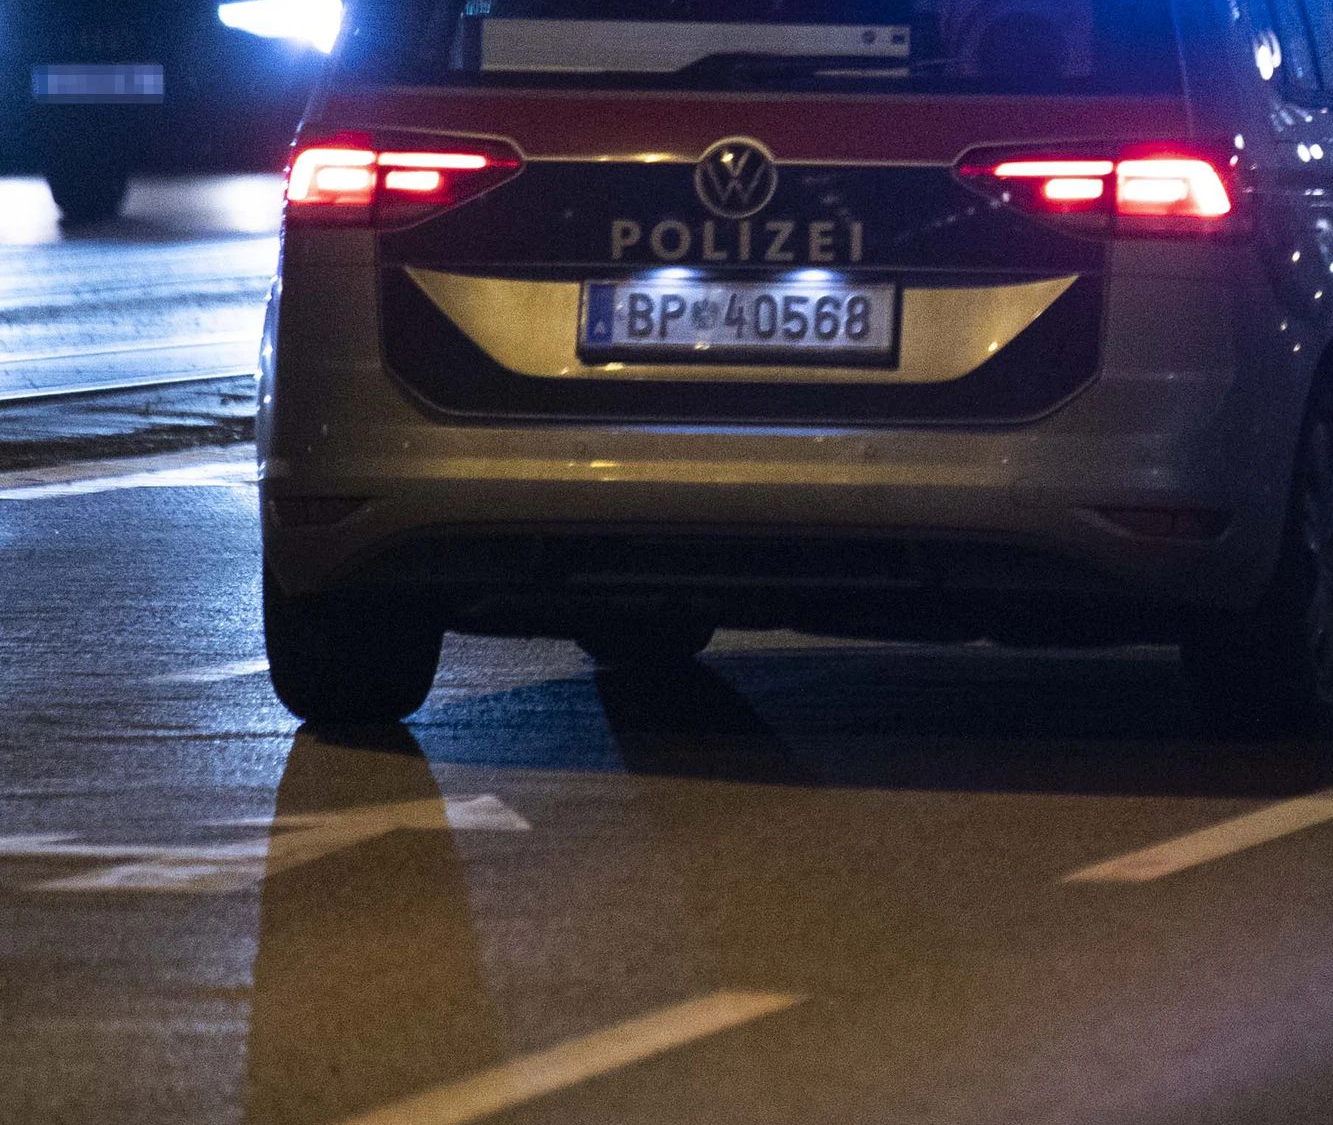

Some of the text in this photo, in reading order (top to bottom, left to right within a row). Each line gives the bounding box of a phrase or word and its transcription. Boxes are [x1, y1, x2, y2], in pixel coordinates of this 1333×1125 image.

[610, 219, 864, 262] POLIZEI
[626, 292, 871, 341] BP 40568
